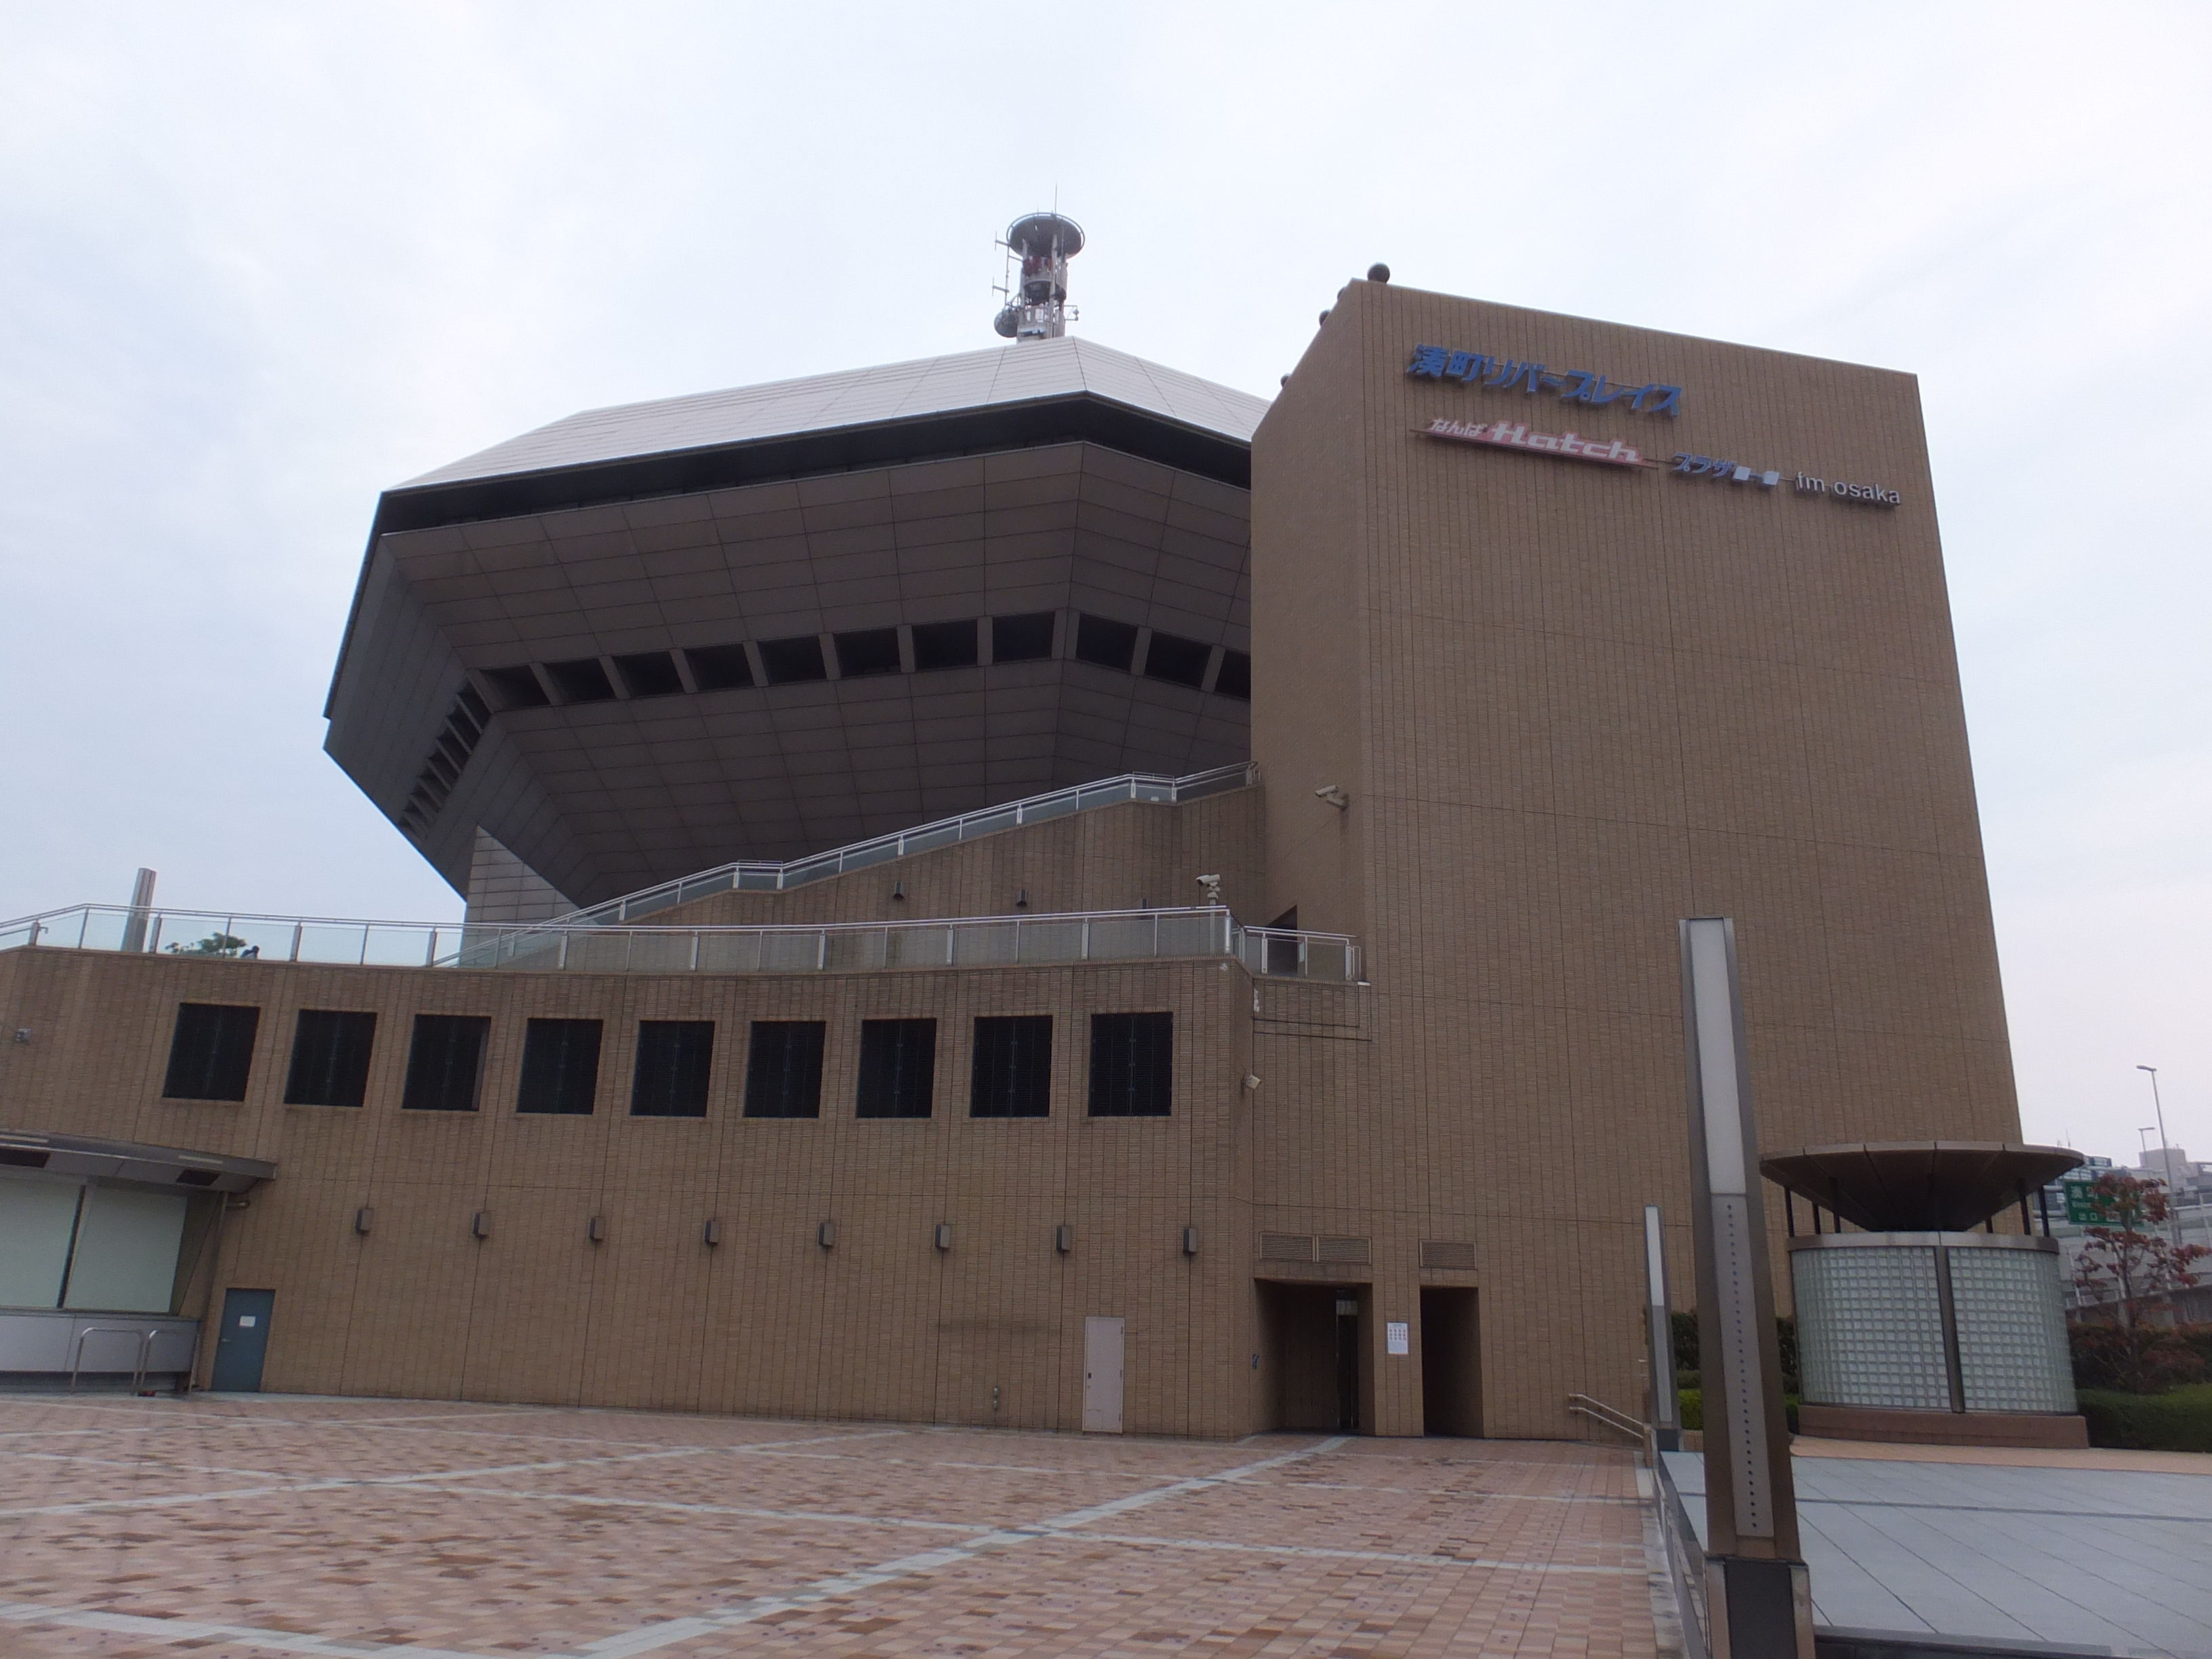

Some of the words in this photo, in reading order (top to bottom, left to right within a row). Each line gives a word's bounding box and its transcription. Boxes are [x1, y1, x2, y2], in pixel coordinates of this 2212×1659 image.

[1407, 344, 1681, 417] 湊町リバープレイス
[1797, 472, 1825, 492] fm
[1832, 481, 1900, 504] osaka
